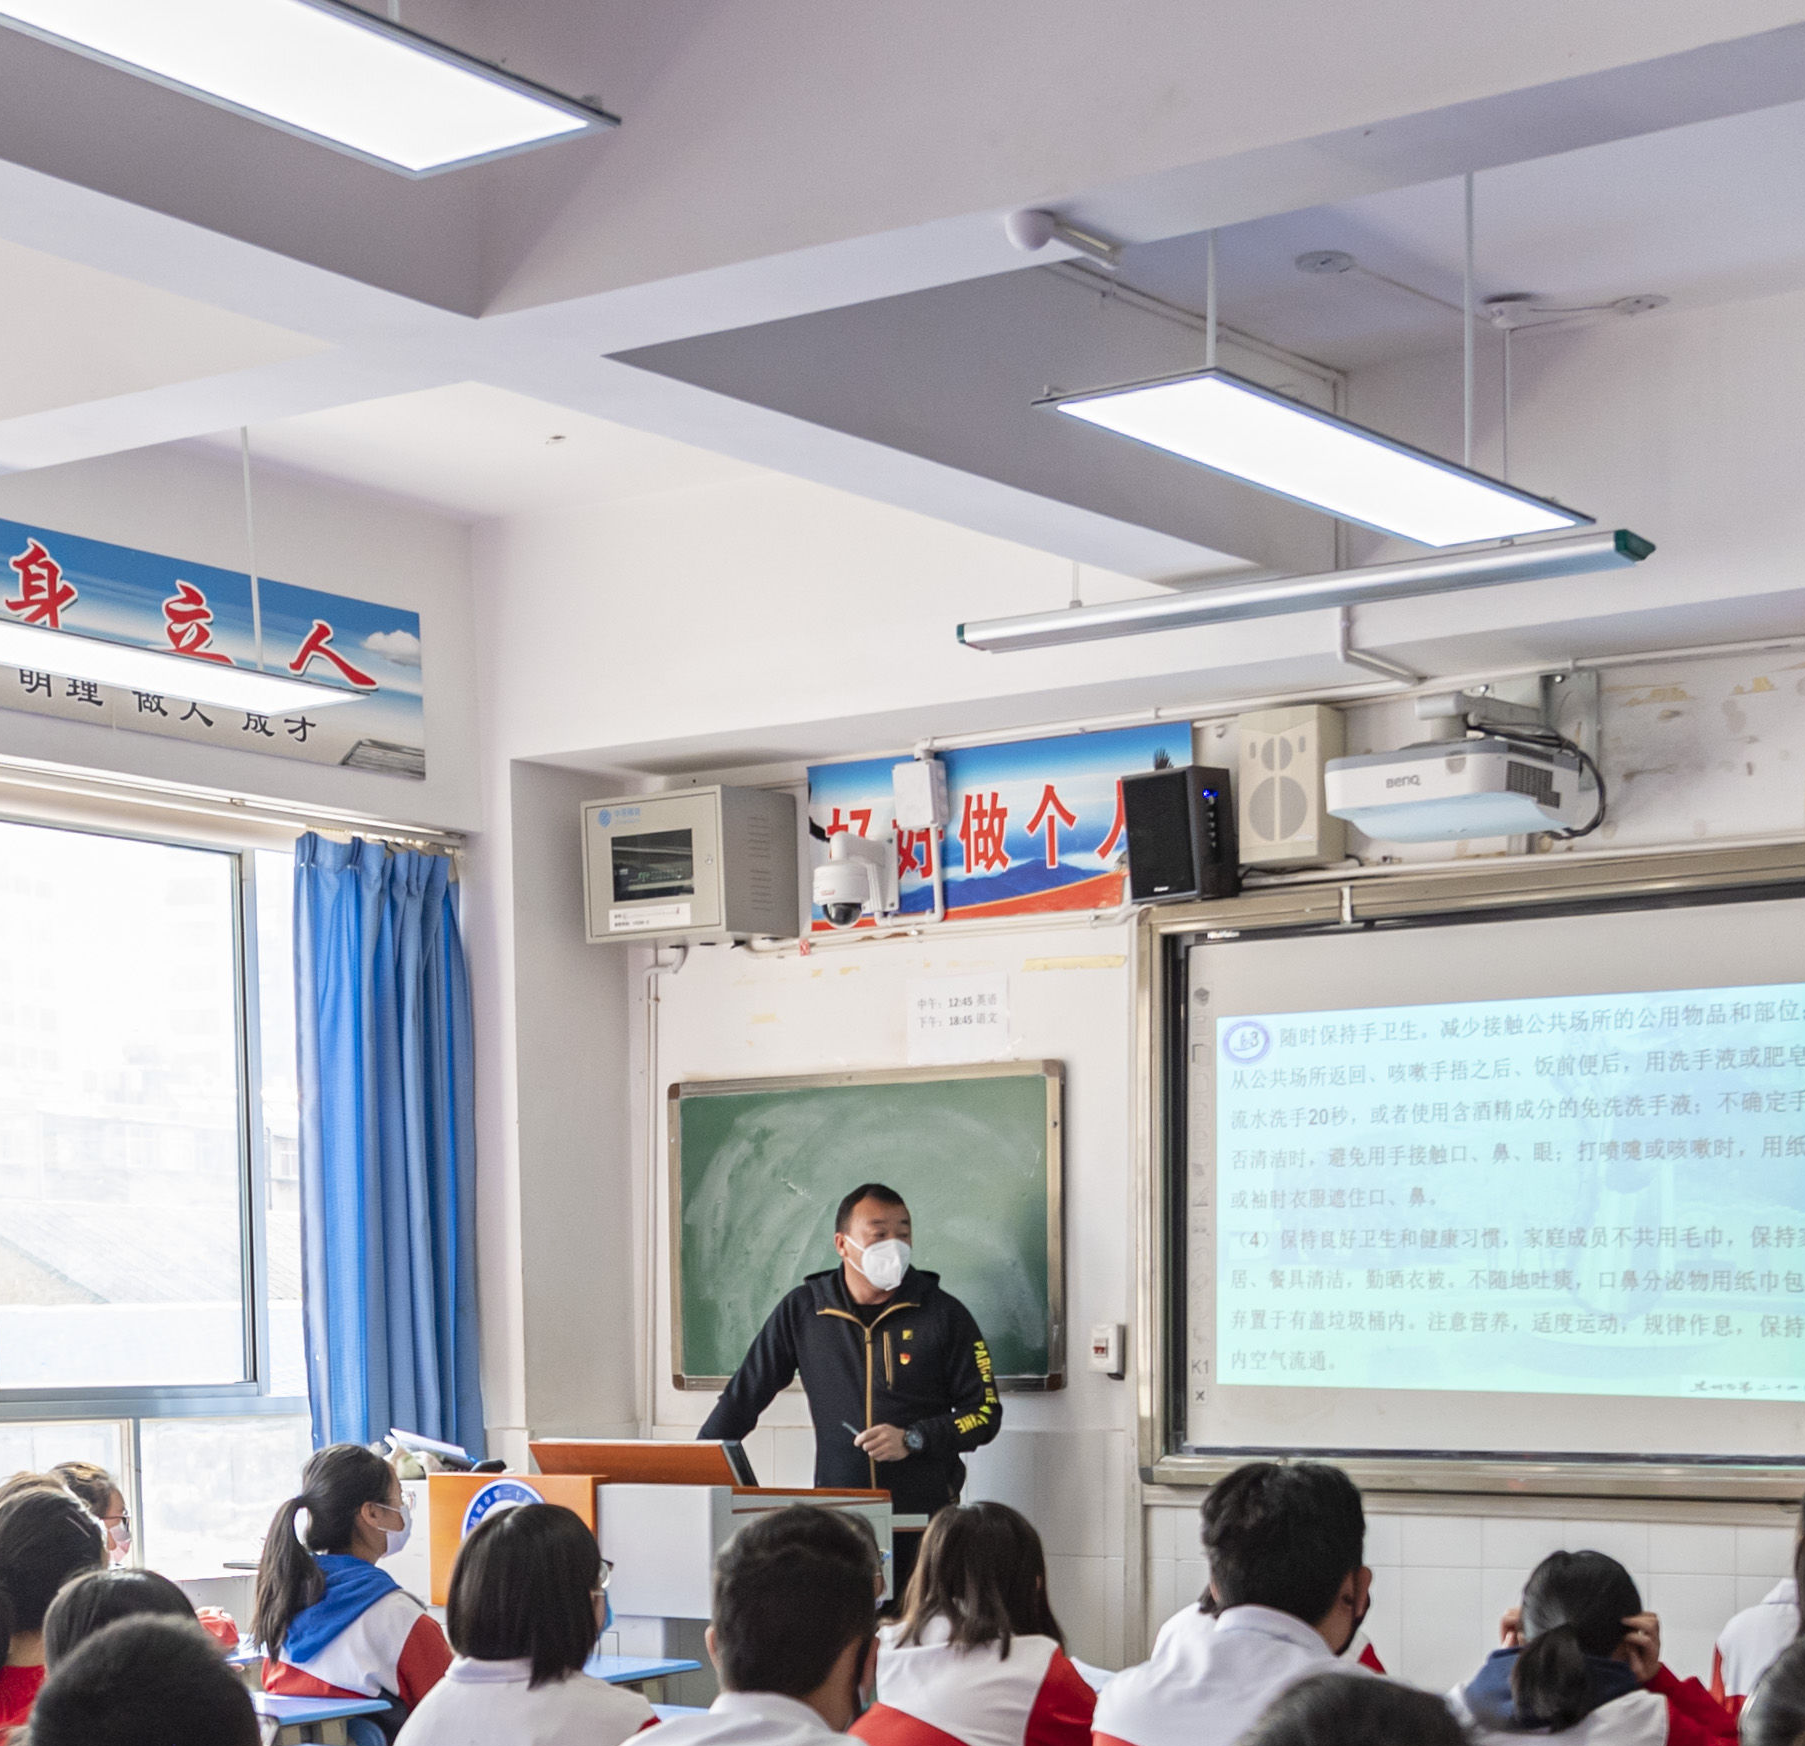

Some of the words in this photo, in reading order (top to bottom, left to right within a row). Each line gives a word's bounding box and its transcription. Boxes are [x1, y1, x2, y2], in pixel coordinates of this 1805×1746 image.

[18, 668, 104, 707] 明理
[132, 690, 214, 727] 做人
[242, 712, 316, 742] 成才
[948, 996, 973, 1008] 12:45
[949, 1015, 973, 1026] 18:45
